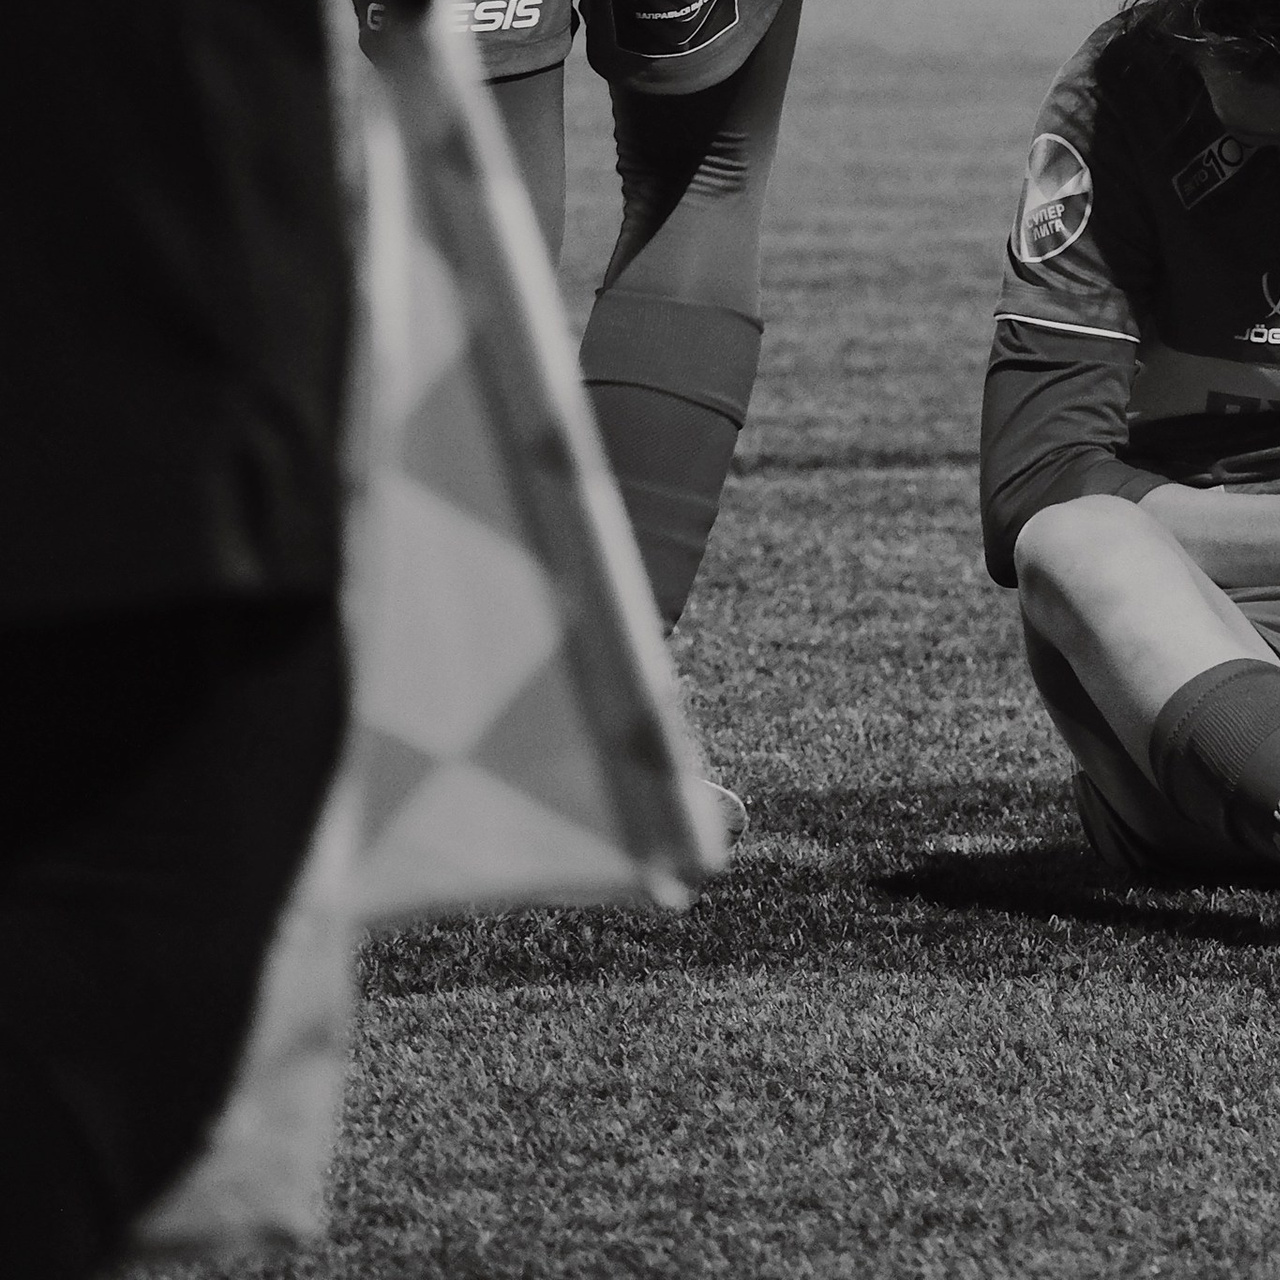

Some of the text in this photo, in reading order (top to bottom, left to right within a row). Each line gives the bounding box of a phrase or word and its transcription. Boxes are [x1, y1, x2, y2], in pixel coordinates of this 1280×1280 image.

[1205, 135, 1244, 180] 10
[1027, 204, 1066, 228] СУПЕР
[1033, 218, 1066, 241] ЛИГА
